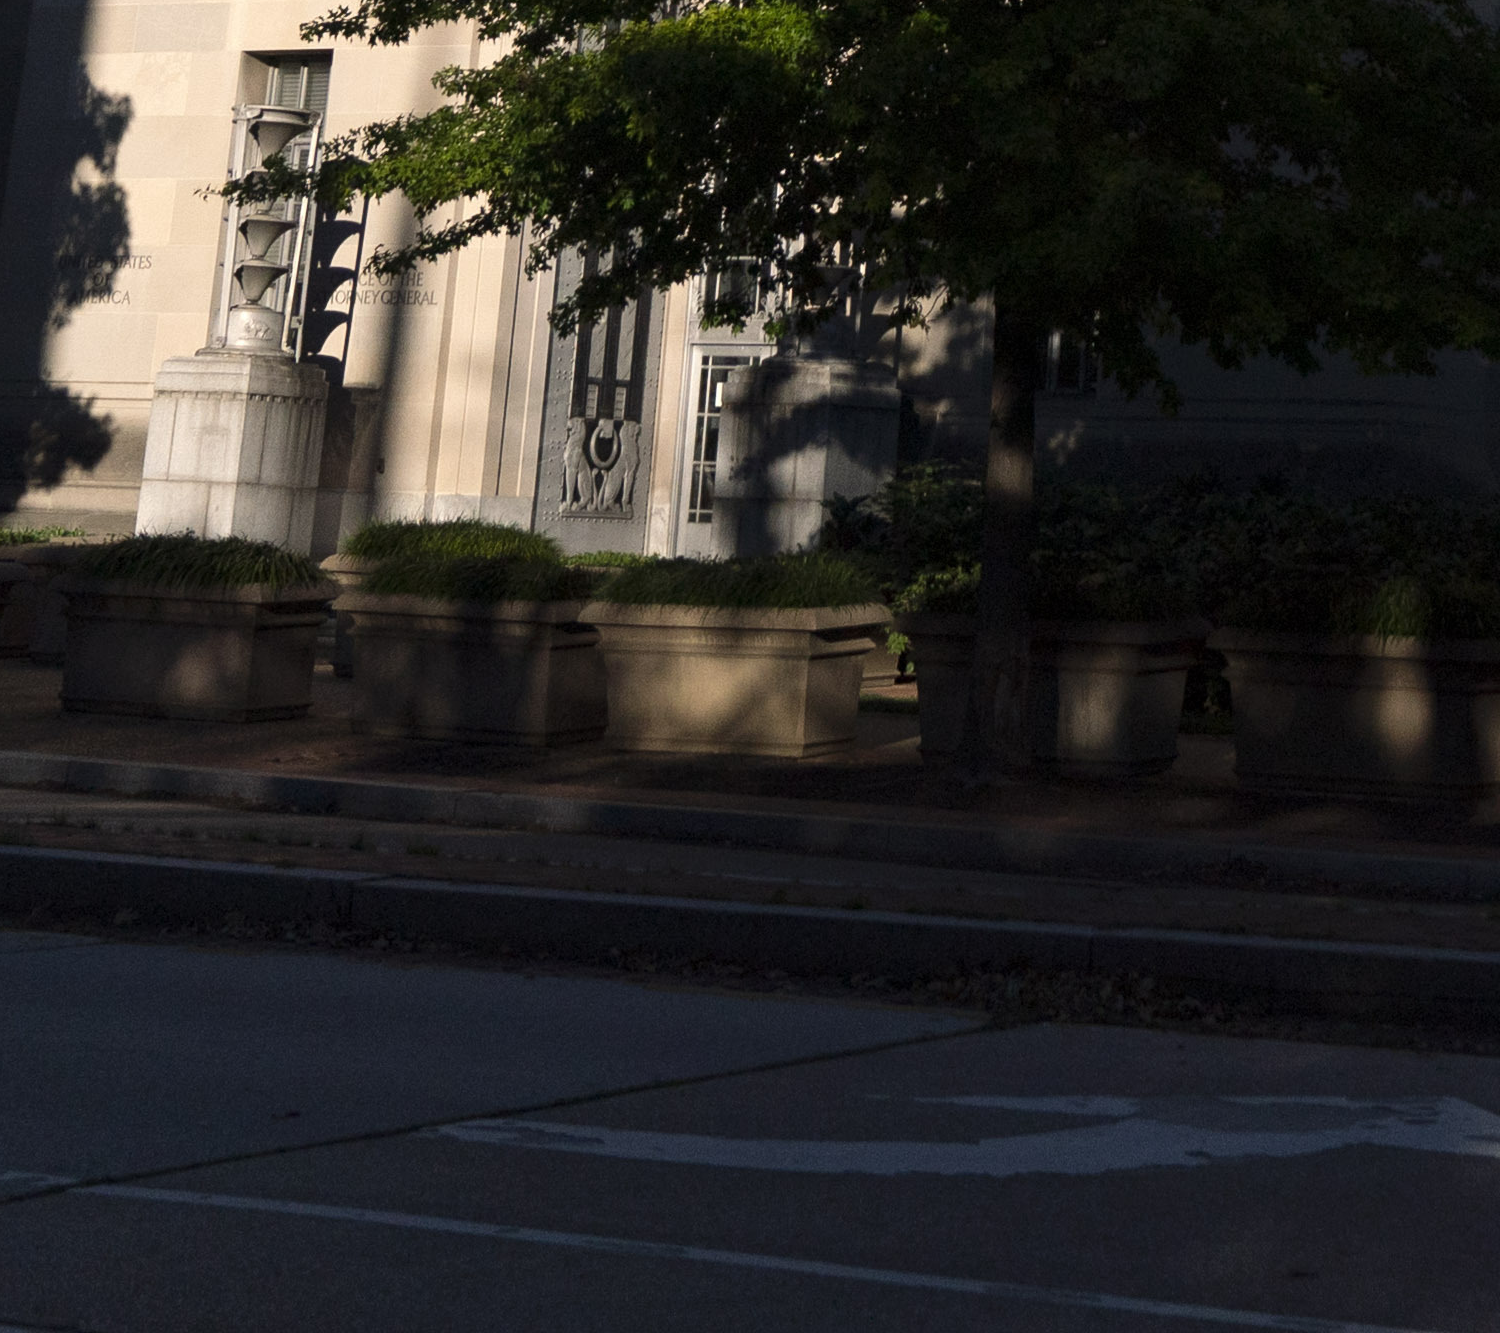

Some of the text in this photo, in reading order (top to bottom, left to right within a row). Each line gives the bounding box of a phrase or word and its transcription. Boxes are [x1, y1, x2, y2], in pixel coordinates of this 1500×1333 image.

[58, 255, 152, 269] UNITED STATES
[93, 272, 111, 286] OF
[378, 272, 394, 287] OF
[399, 272, 424, 287] THE
[67, 289, 130, 305] AMERICA
[381, 290, 438, 305] GENERAL
